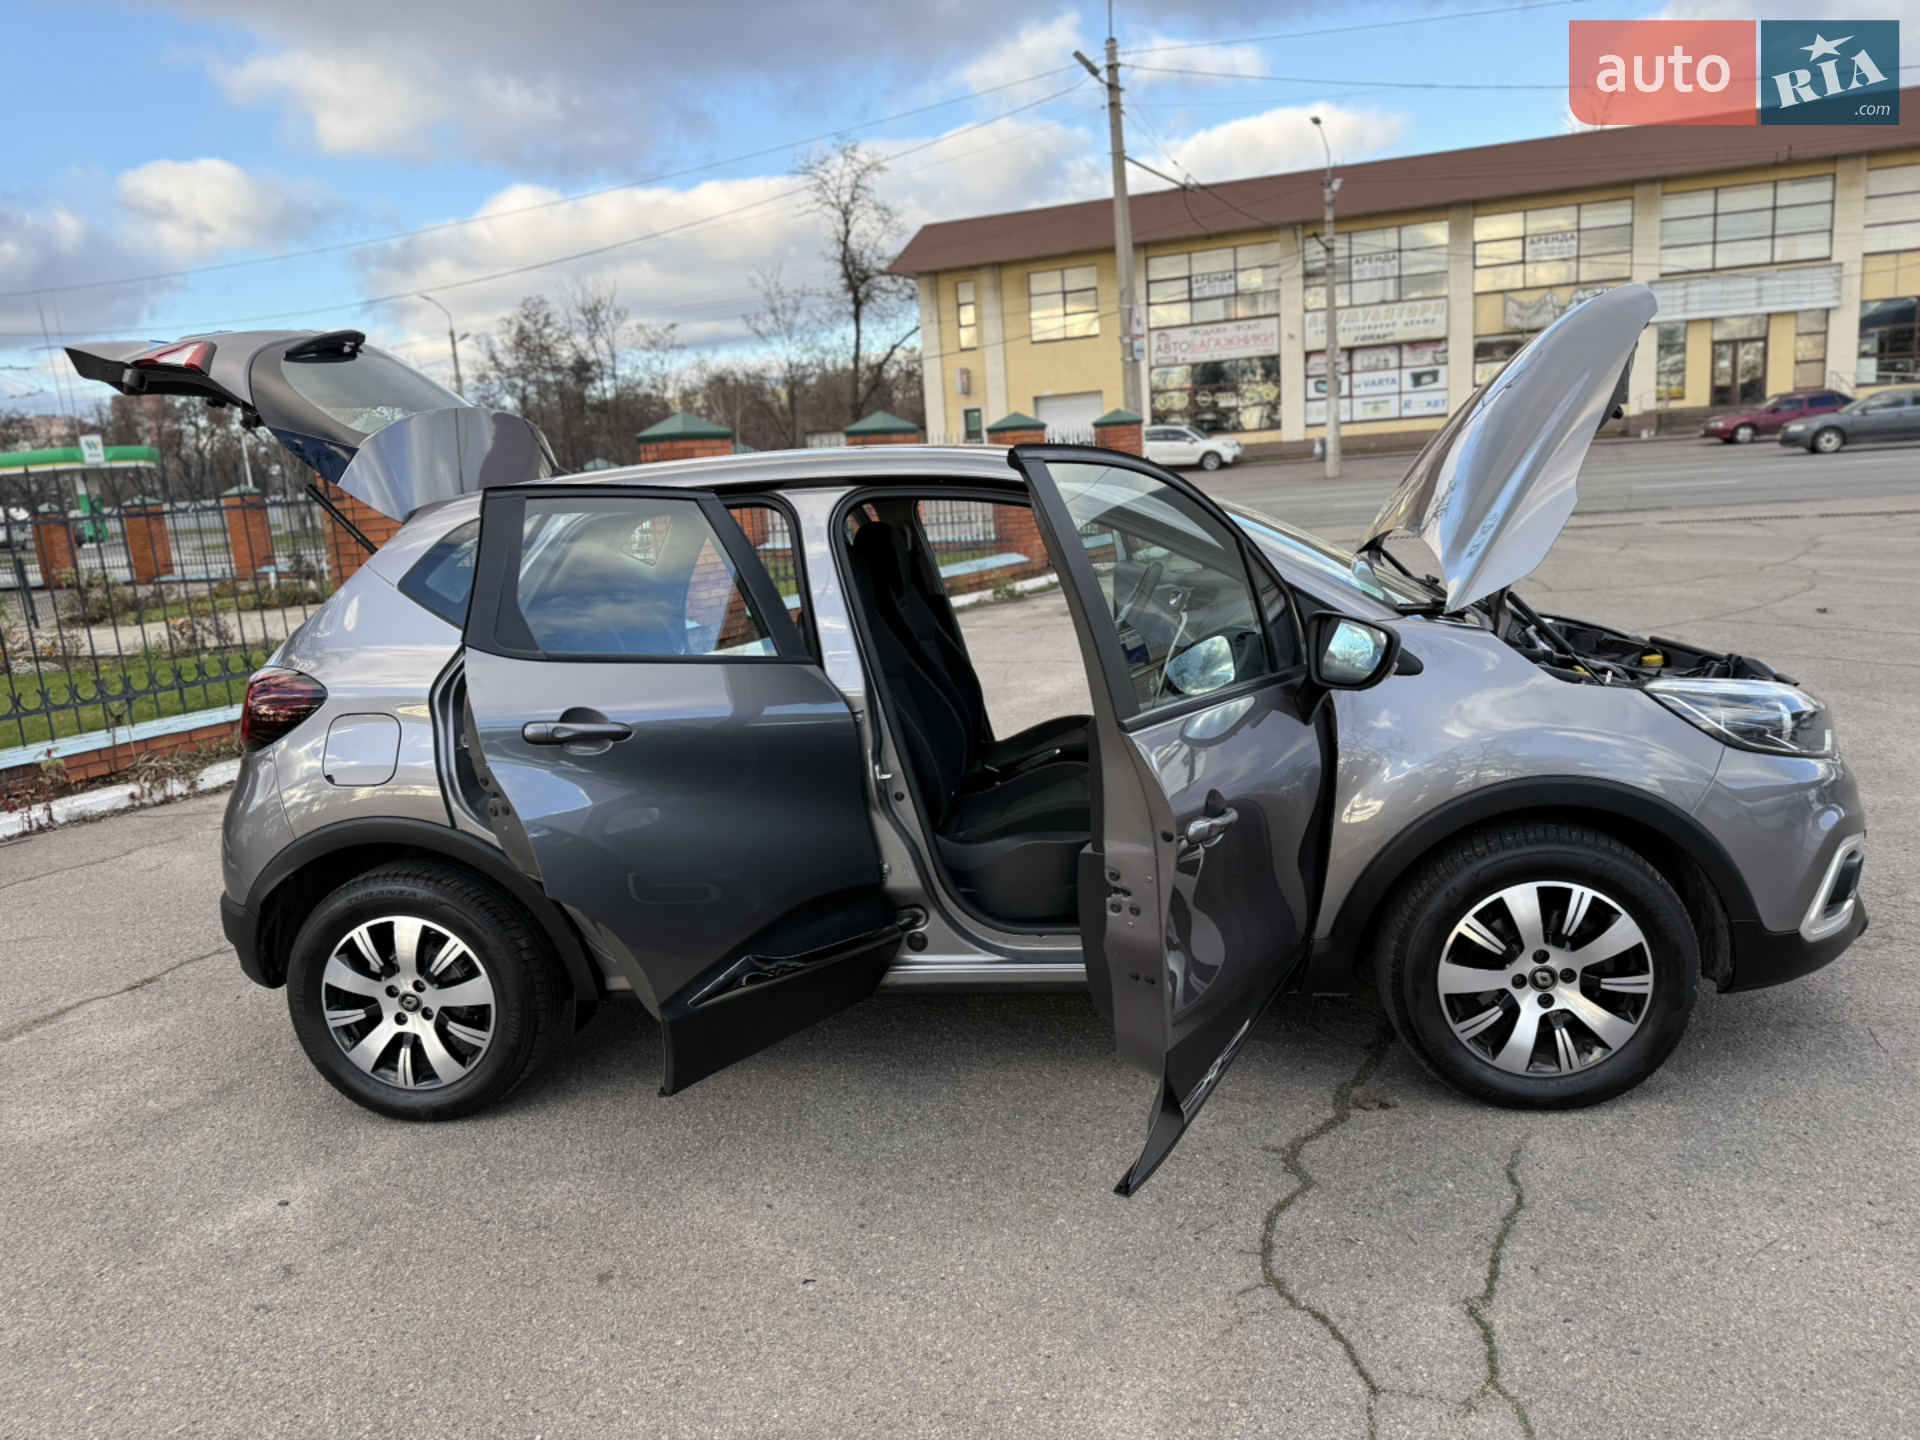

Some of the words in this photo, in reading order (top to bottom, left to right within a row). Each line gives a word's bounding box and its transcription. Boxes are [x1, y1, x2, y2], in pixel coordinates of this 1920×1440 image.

[1528, 233, 1576, 245] АРЕНДА
[1354, 253, 1397, 266] АРЕНДА
[1194, 272, 1234, 286] АРЕНДА
[1189, 326, 1226, 337] ПРОДАЖА
[1233, 322, 1261, 333] ПРОКАТ
[1155, 332, 1275, 354] АВТОБАГАЖНИКИ
[1363, 377, 1398, 388] VARTA
[346, 889, 418, 905] TURANZA
